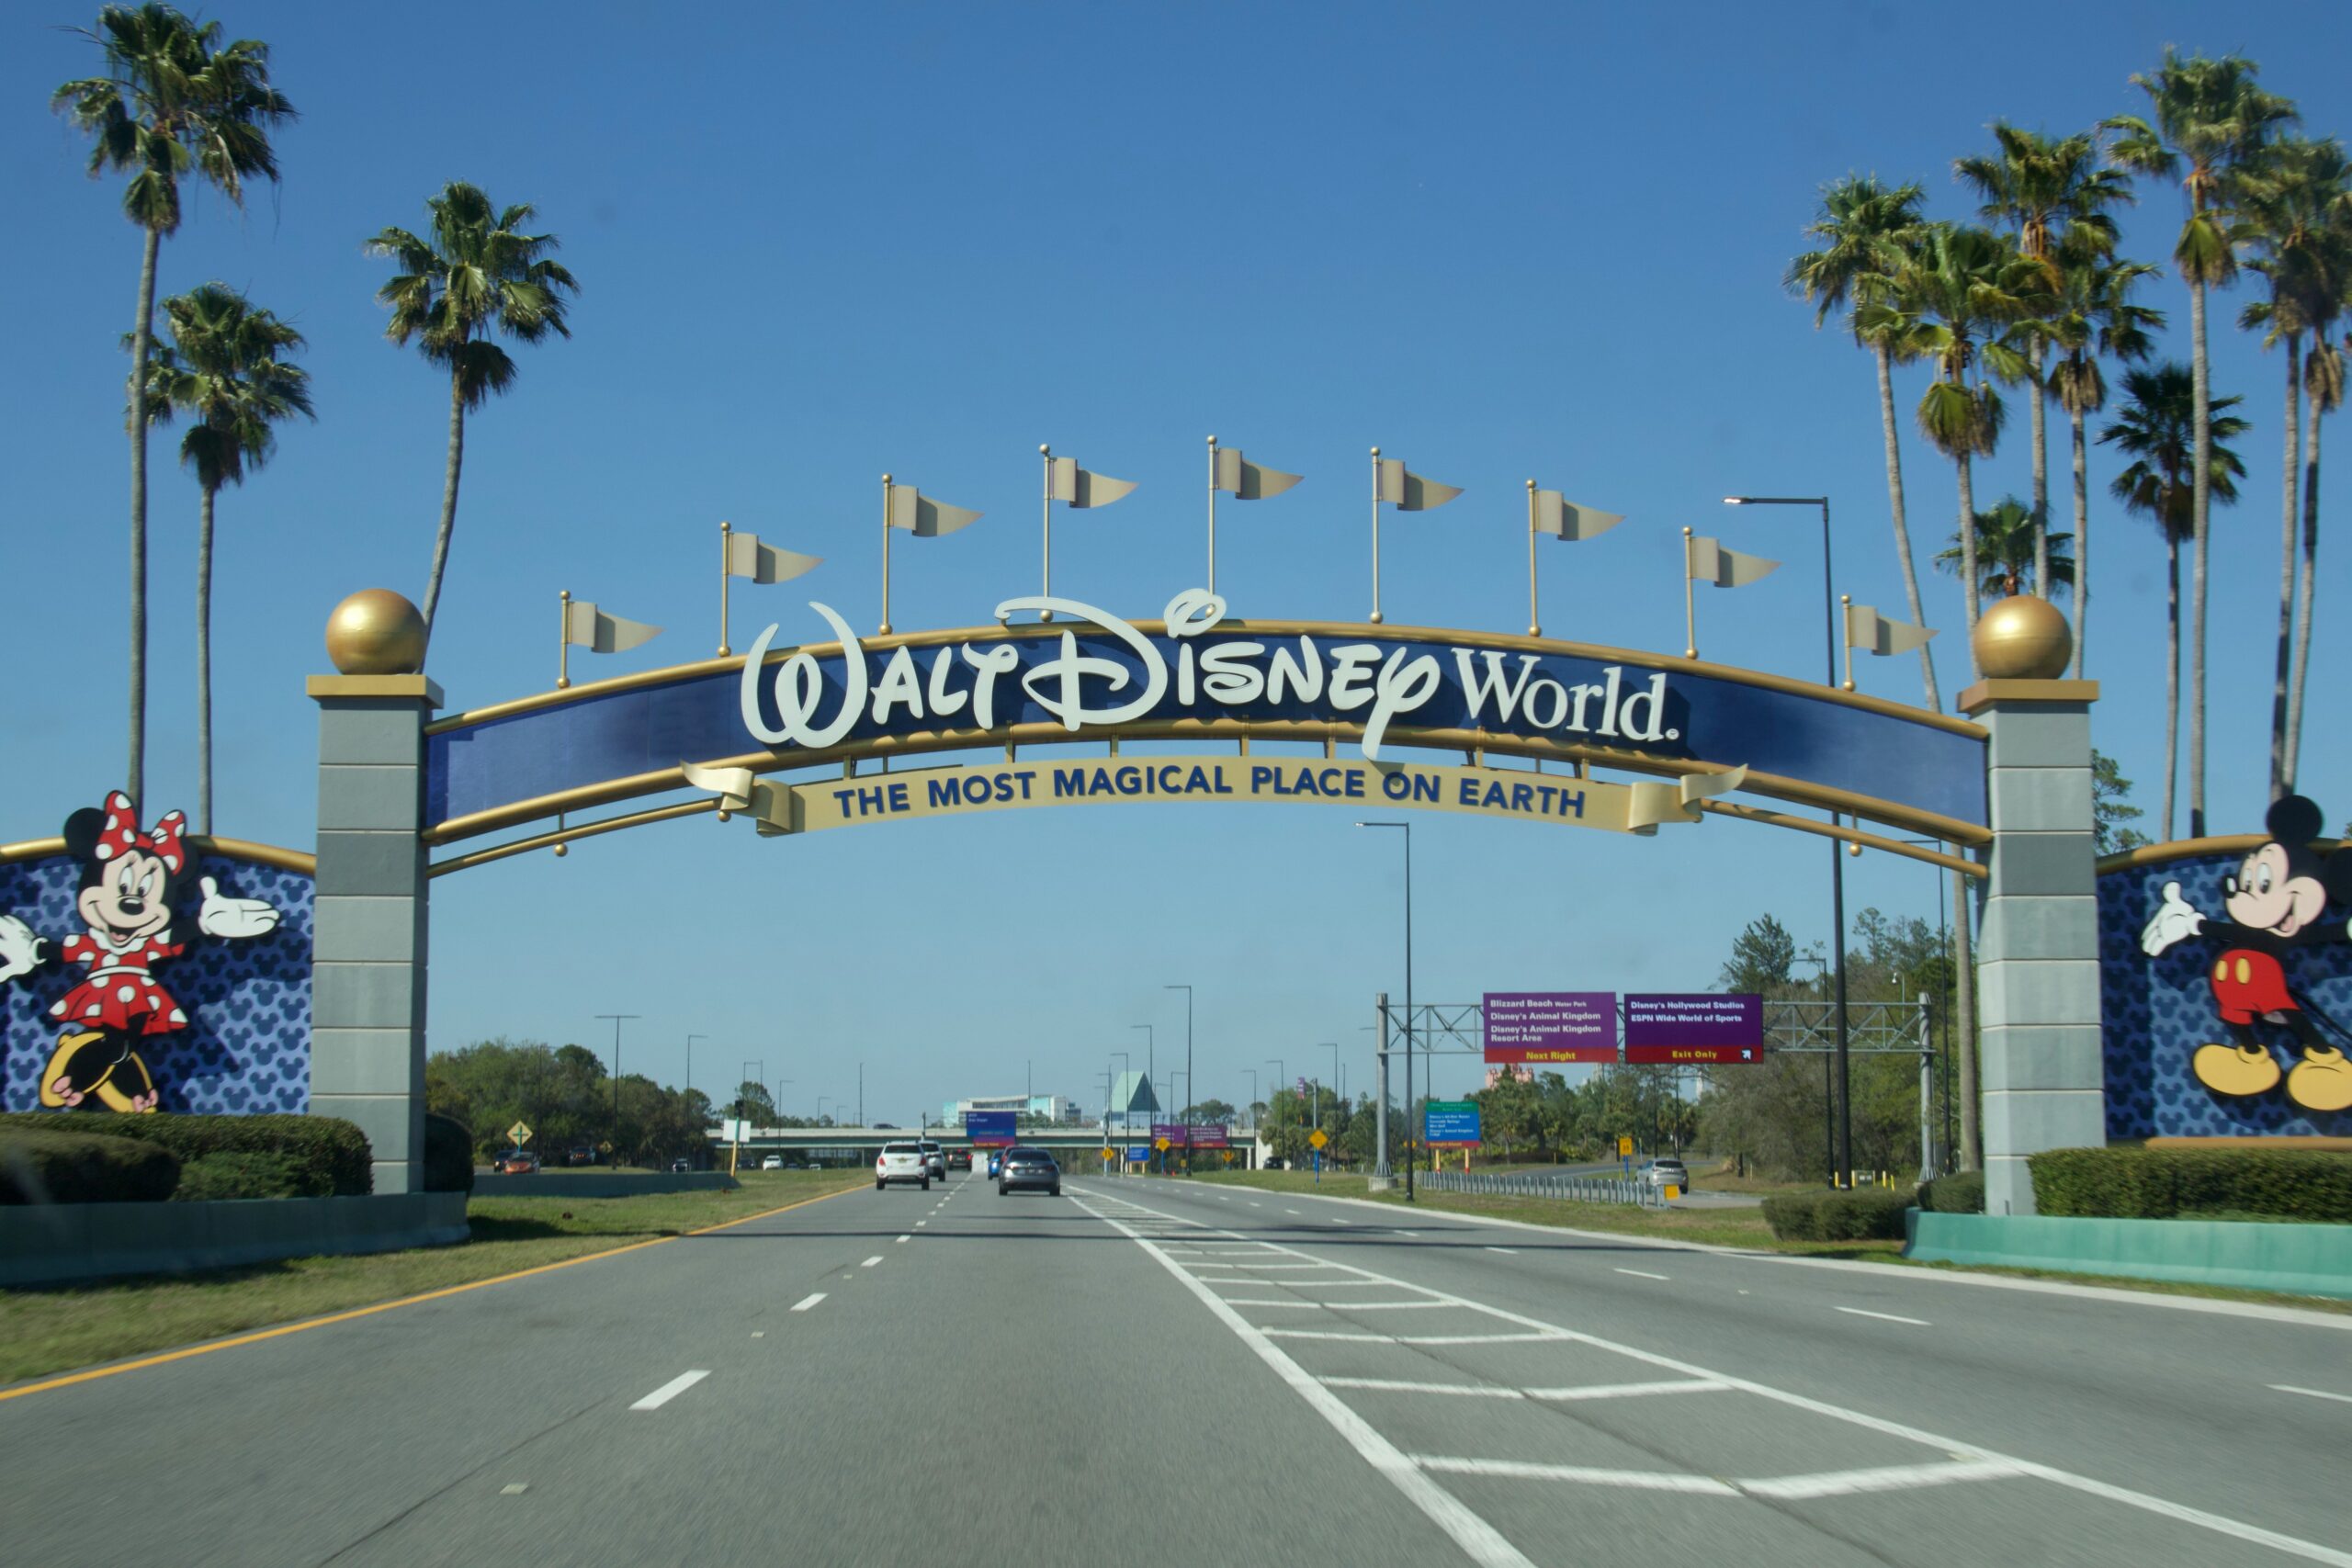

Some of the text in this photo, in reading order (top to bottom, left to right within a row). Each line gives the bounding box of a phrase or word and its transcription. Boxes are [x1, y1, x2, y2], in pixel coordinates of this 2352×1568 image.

[833, 764, 1585, 818] THE MOST MAGICAL PLACE ON EARTH
[1490, 999, 1525, 1008] Blizzard
[1527, 999, 1553, 1008] Beach
[1631, 1001, 1745, 1010] Disney's Hollywood Studios
[1490, 1012, 1601, 1021] Disney's Animal Kingdom
[1631, 1014, 1742, 1023] ESPN Wide World of Sports
[1490, 1025, 1601, 1034] Disney's Animal Kingdom
[1526, 1051, 1576, 1061] Next Right
[1672, 1050, 1717, 1059] Exit Only
